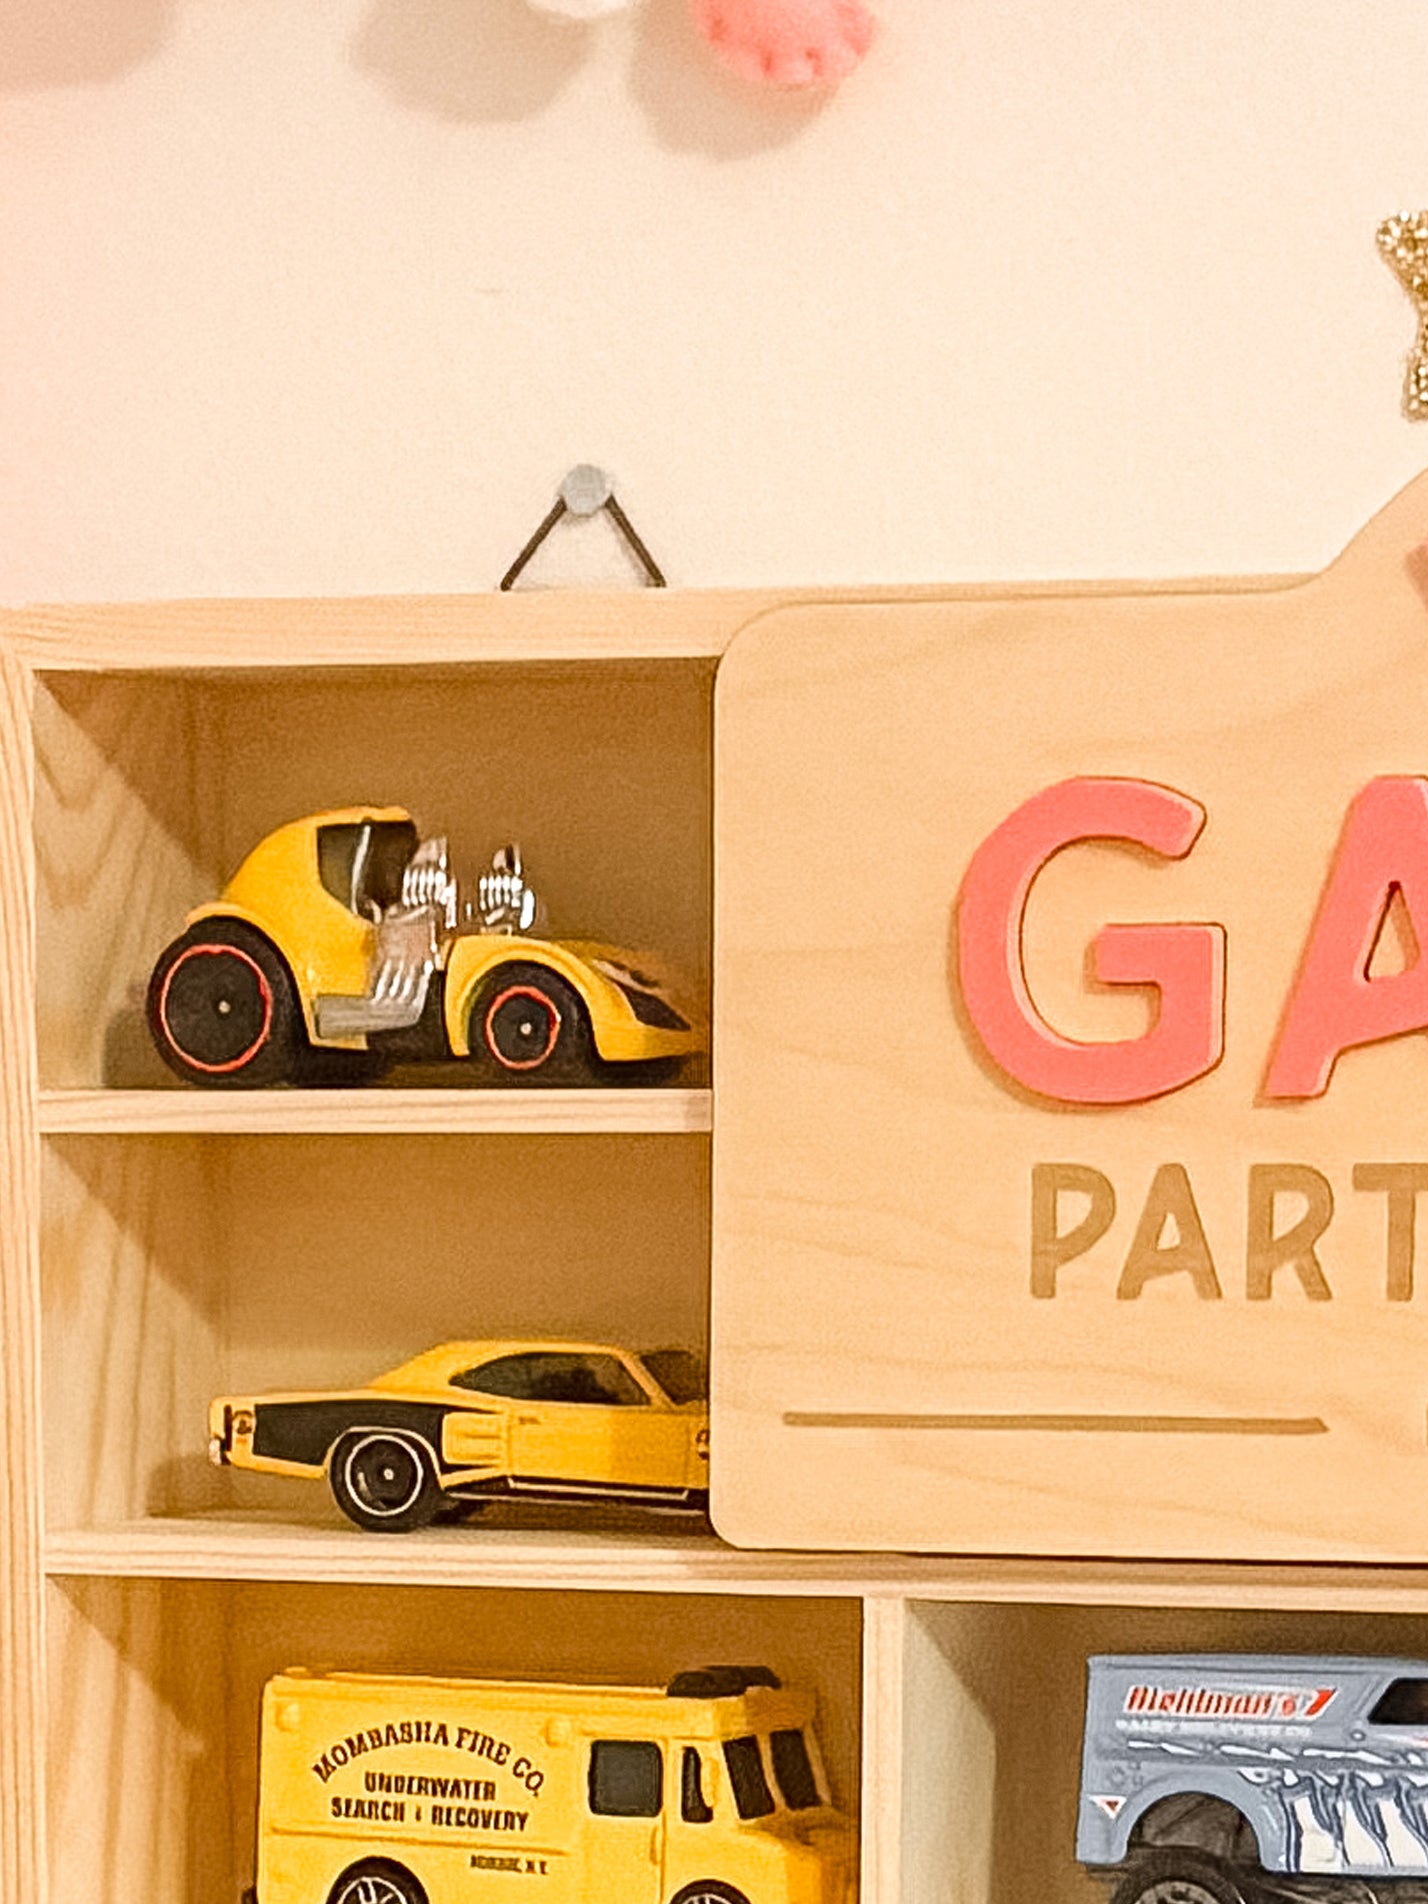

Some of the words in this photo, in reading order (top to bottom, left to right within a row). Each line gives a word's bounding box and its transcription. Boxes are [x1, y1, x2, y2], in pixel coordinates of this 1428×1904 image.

[454, 1726, 512, 1766] FIRE
[363, 1771, 497, 1802] UNDERWATER
[331, 1796, 406, 1823] SEARCH
[431, 1804, 530, 1832] RECOVERY
